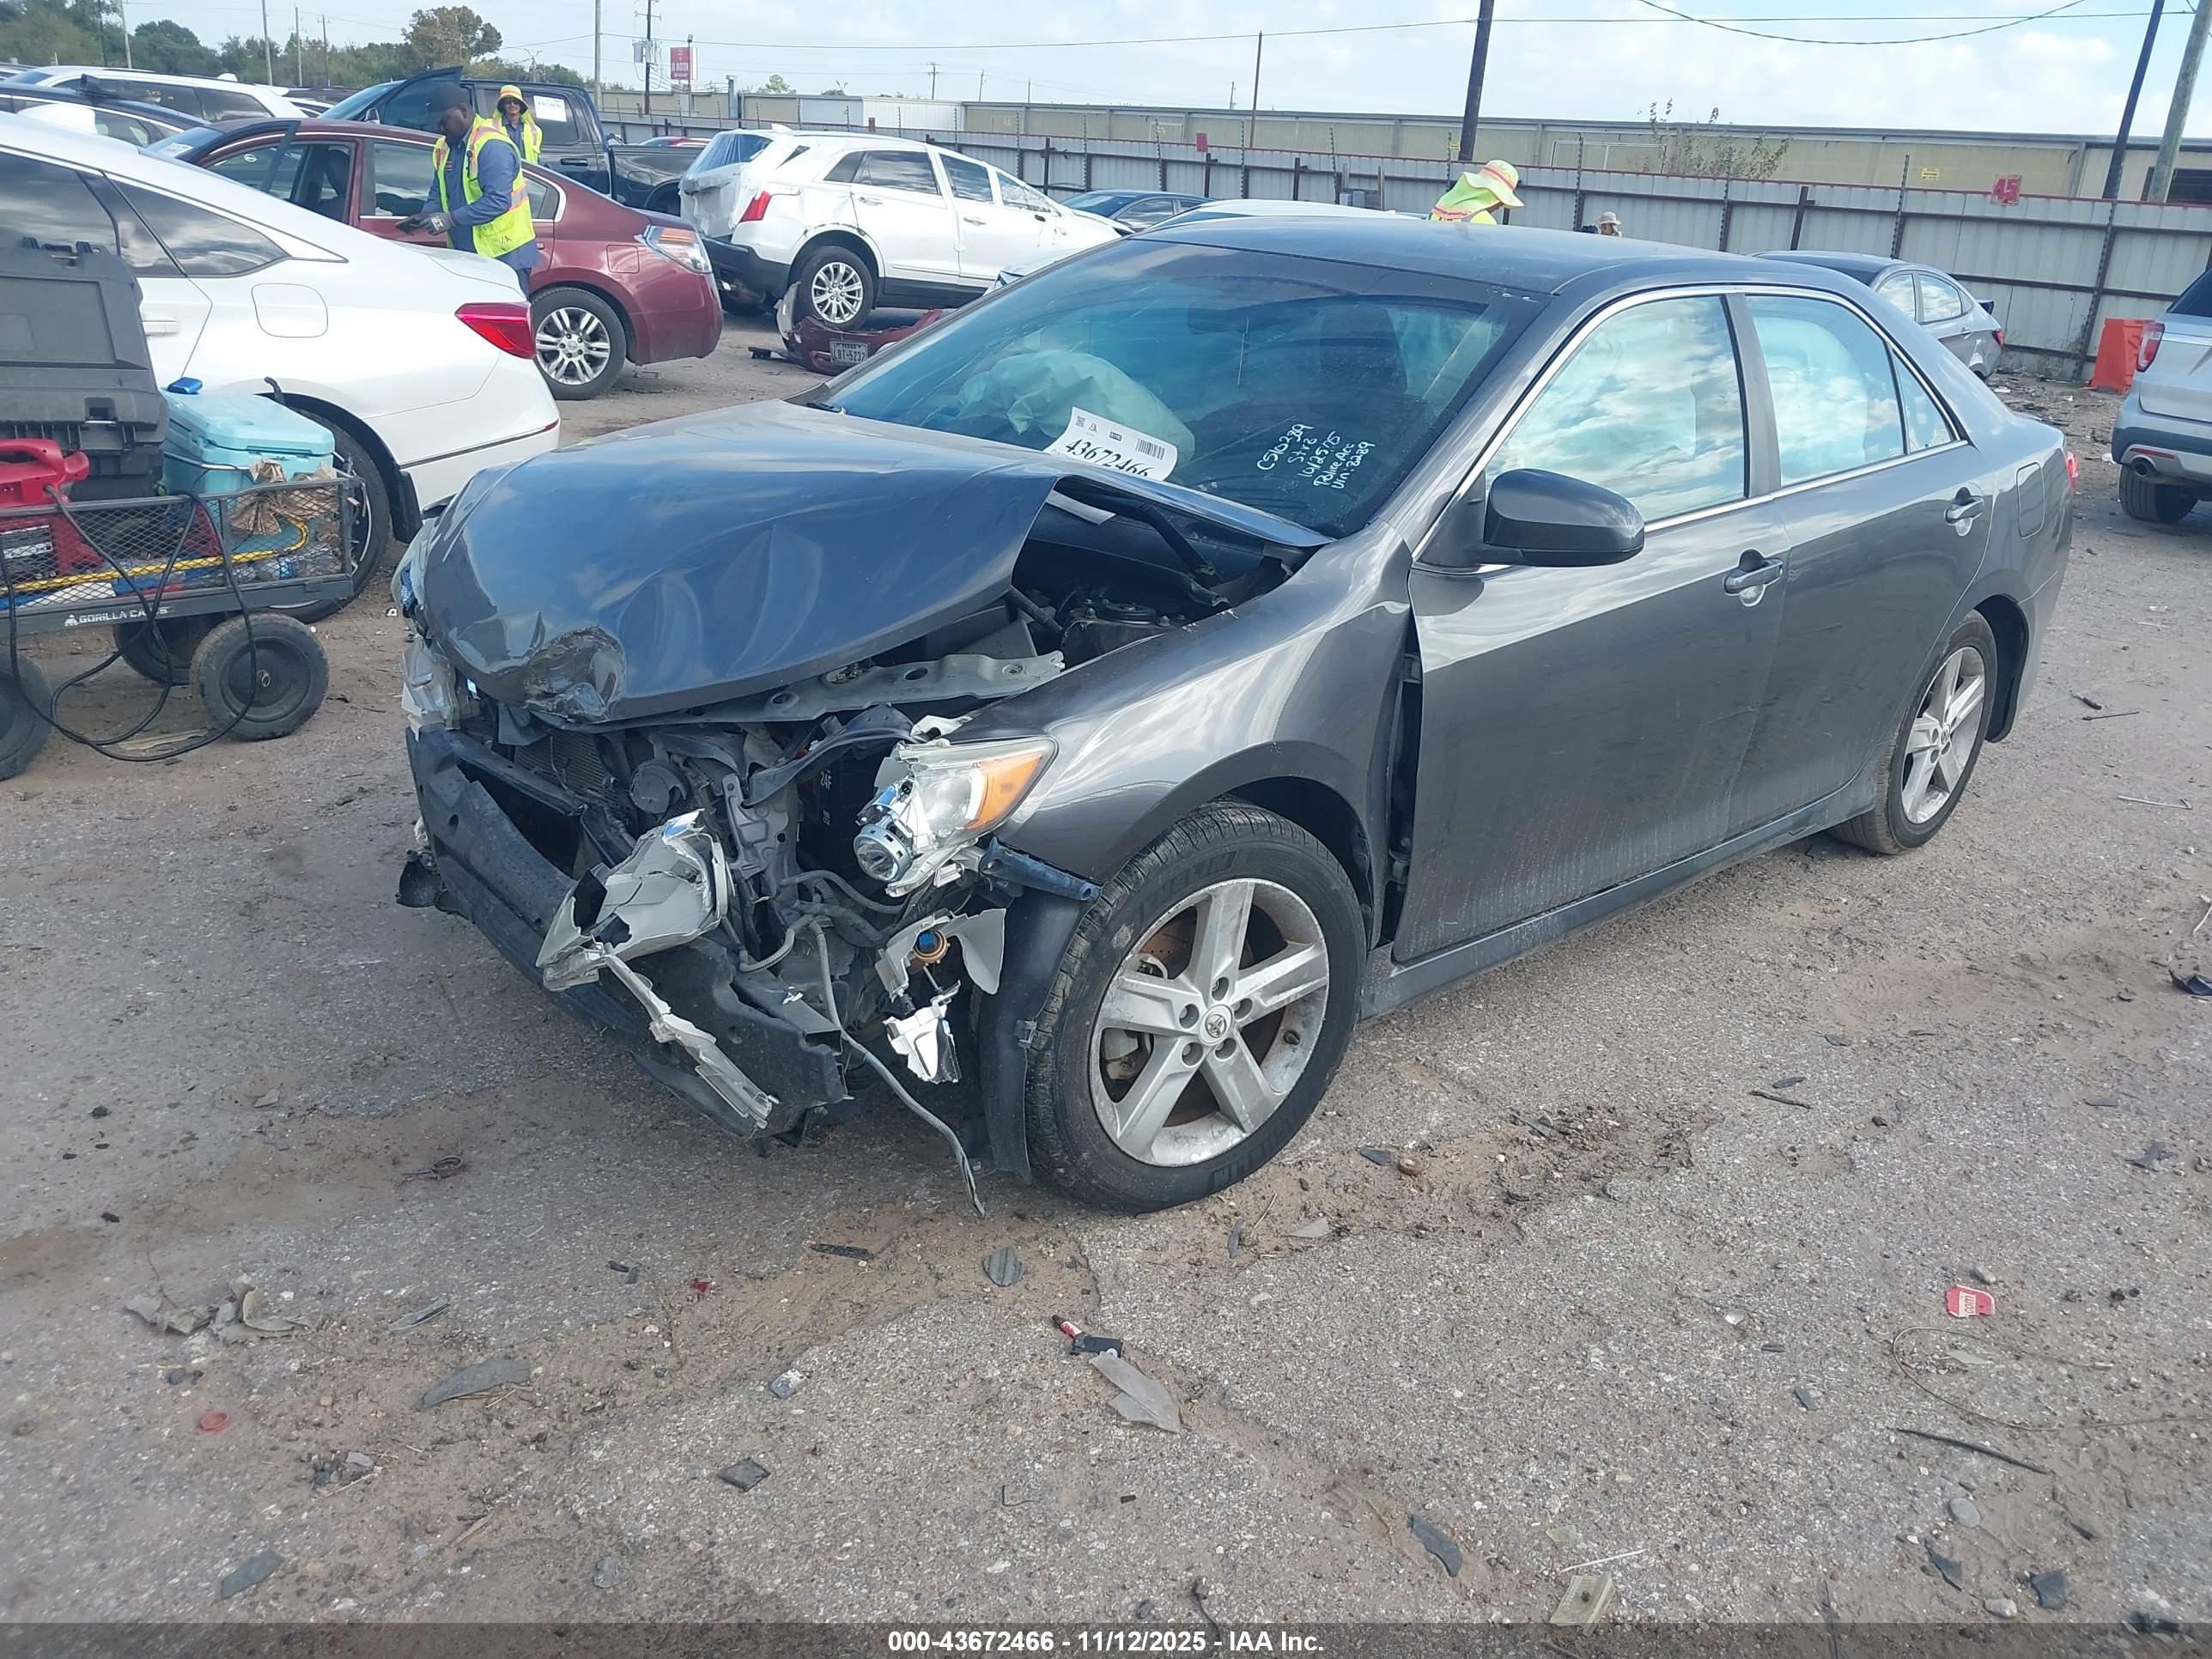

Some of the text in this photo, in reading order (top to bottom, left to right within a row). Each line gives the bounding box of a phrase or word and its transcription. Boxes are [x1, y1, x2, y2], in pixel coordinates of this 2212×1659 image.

[1992, 178, 2021, 204] 45
[78, 606, 169, 624] GORILLA CAS
